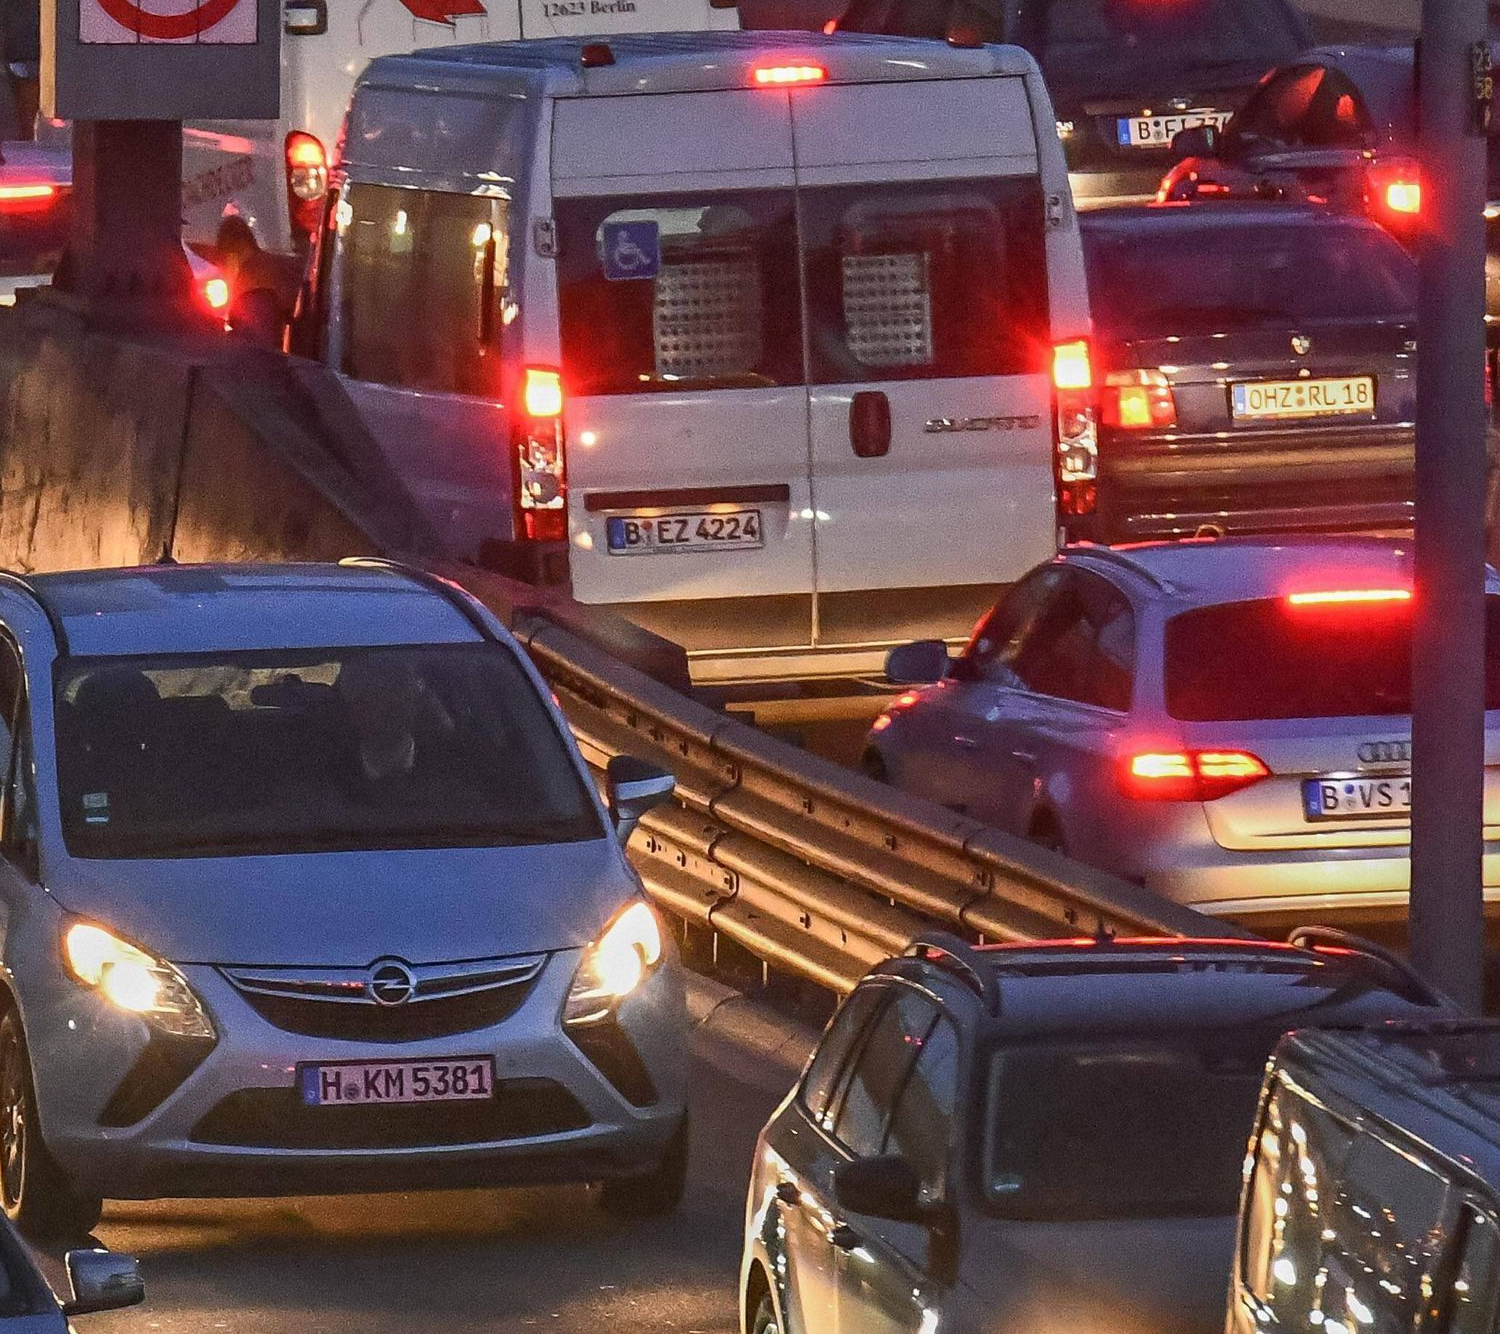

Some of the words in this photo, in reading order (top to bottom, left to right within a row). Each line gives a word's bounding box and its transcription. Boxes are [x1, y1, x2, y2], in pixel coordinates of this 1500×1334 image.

[1139, 121, 1151, 139] B
[1249, 387, 1292, 410] OHZ
[1308, 384, 1336, 406] RL
[1343, 382, 1368, 405] 18
[624, 522, 640, 545] B
[658, 520, 689, 544] EZ
[695, 517, 758, 541] 4224
[1322, 784, 1339, 811] B
[1359, 783, 1391, 809] VS
[322, 1071, 342, 1101] H
[363, 1068, 405, 1099] KM
[412, 1065, 489, 1096] 5381
